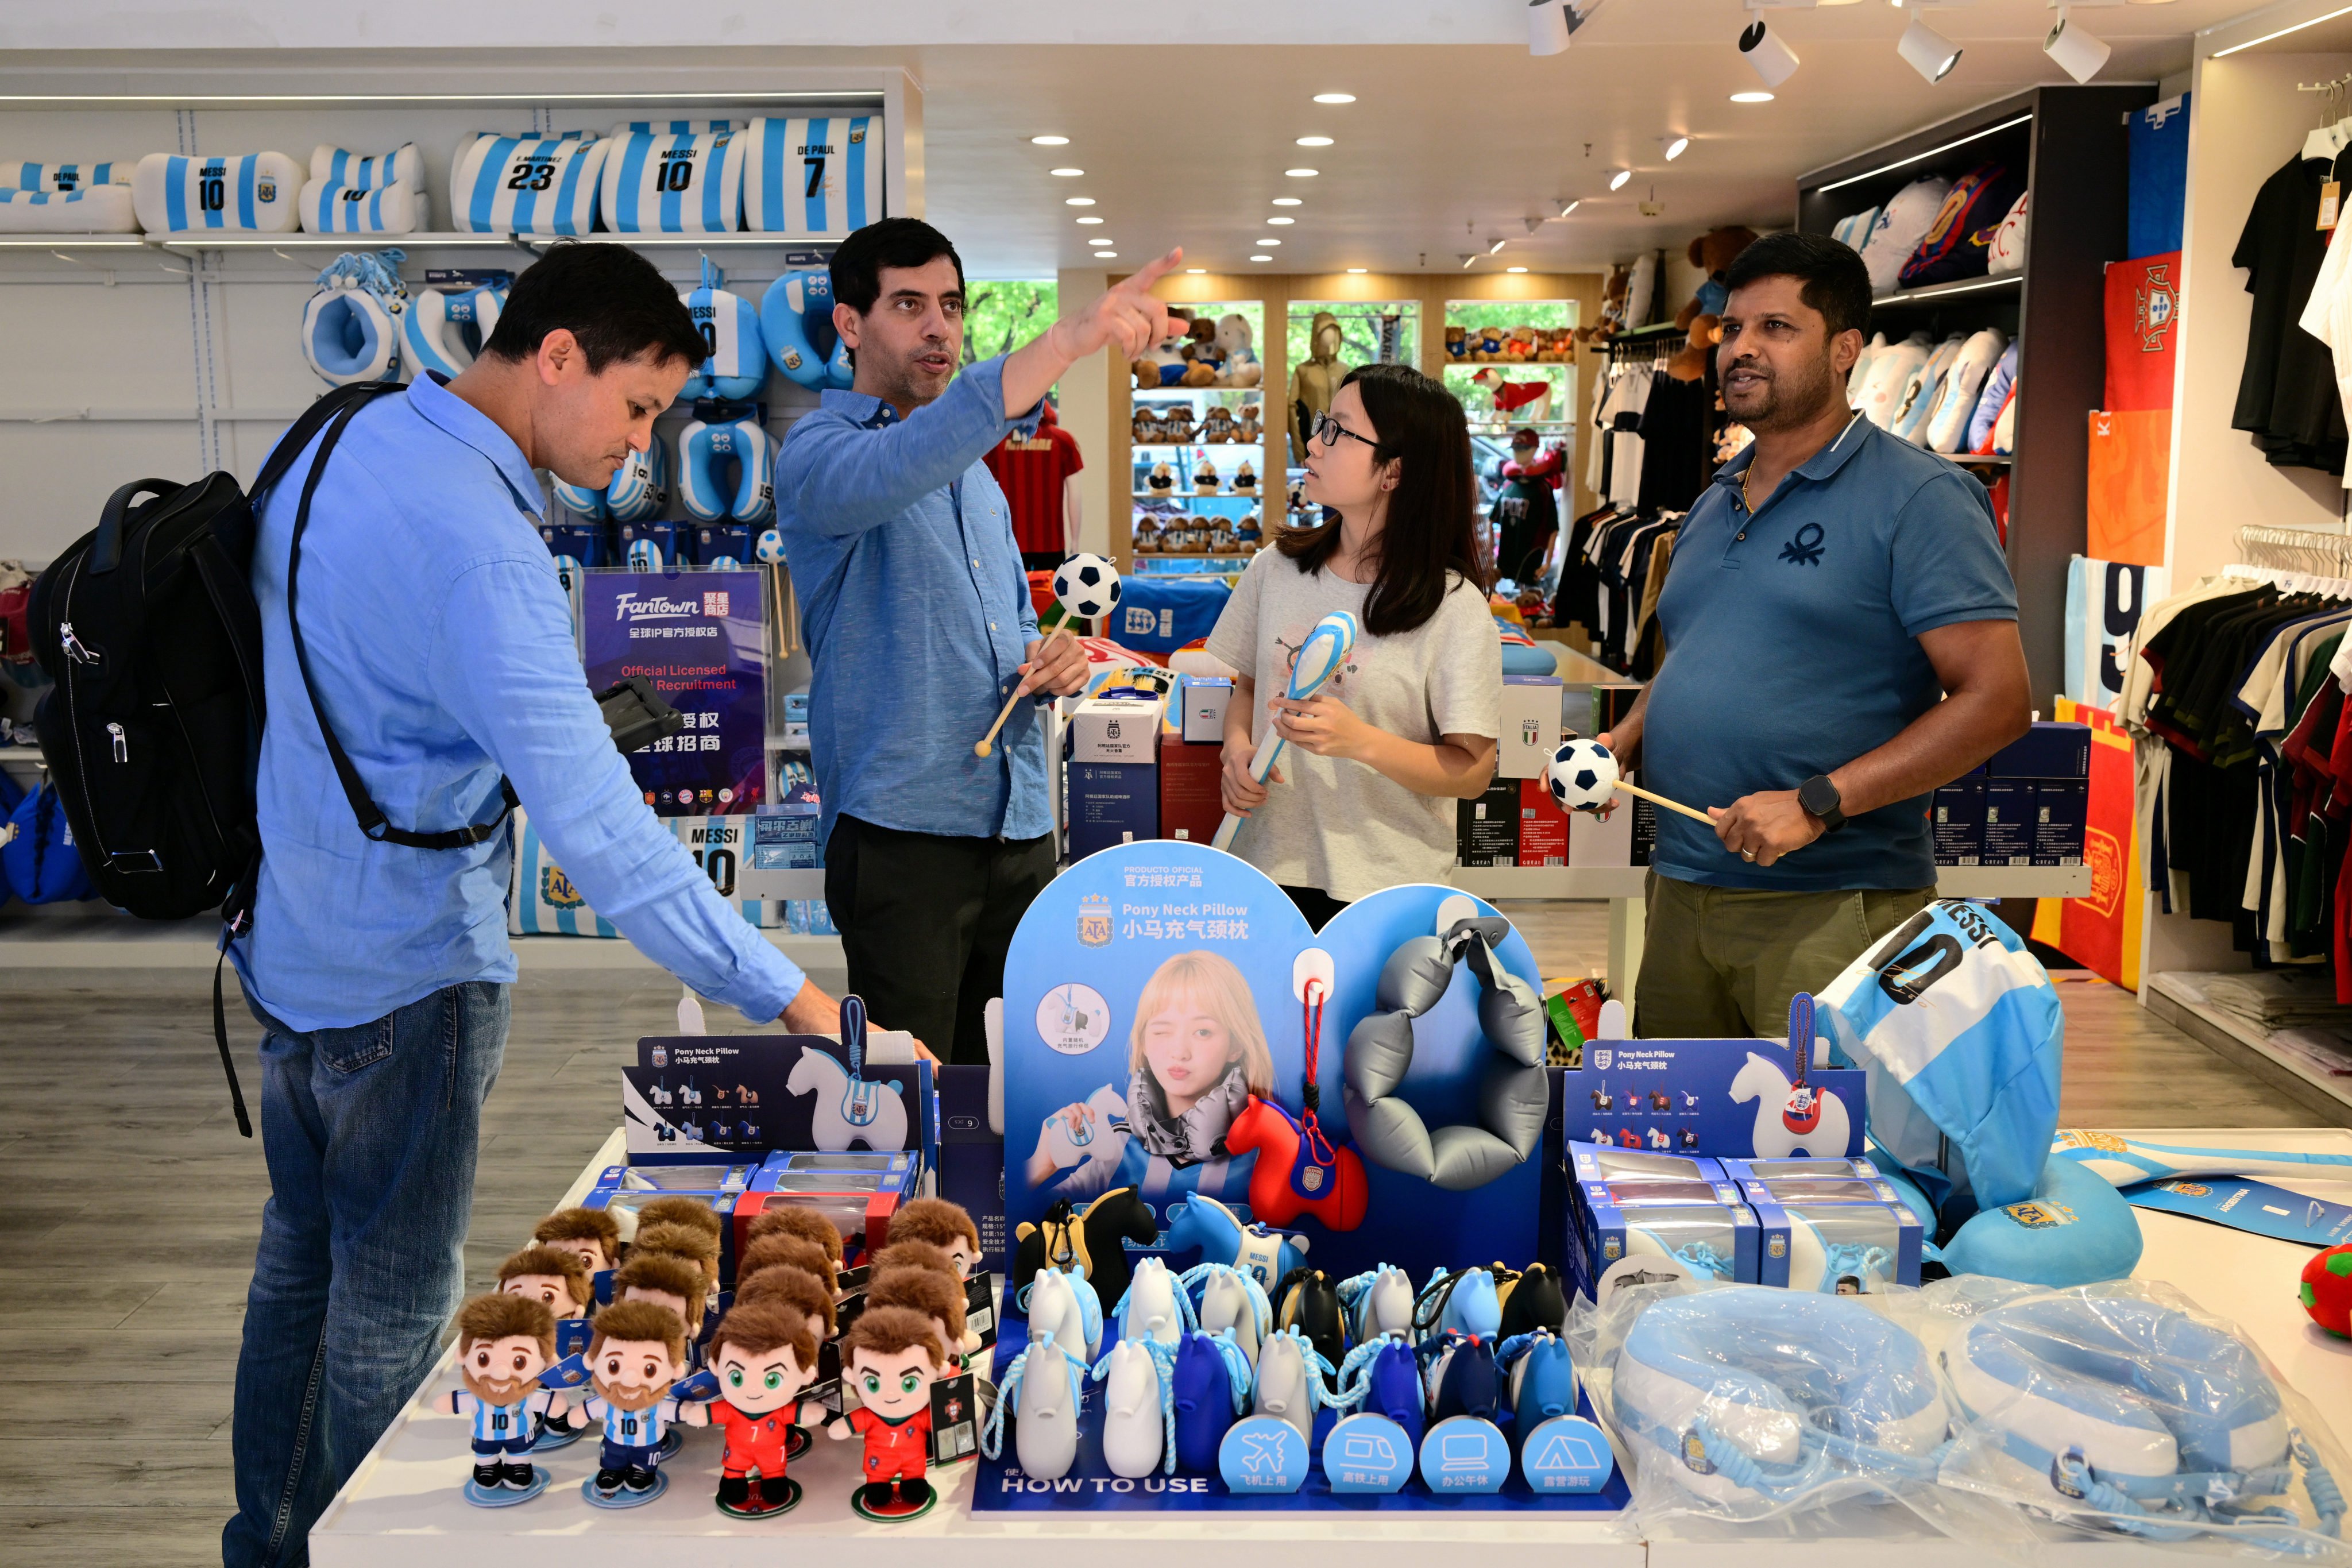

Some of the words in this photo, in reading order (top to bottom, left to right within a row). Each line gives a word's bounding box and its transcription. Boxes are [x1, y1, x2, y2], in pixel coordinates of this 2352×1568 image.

[661, 149, 697, 159] MESSI
[798, 146, 810, 155] DE
[813, 145, 835, 155] PAUL
[199, 167, 226, 176] MESSI
[508, 164, 556, 191] 23
[656, 161, 693, 191] 10
[804, 157, 825, 198] 7
[199, 179, 225, 211] 10
[689, 306, 716, 318] ESSI
[698, 322, 717, 357] 0
[616, 593, 700, 621] FanTown
[629, 627, 717, 638] 全球IP官方授权店
[621, 665, 666, 677] Official
[670, 664, 727, 675] Licensed
[657, 679, 736, 690] Recruitment
[691, 828, 738, 844] MESSI
[1124, 874, 1202, 887] 官方授权产品
[1122, 904, 1159, 918] Pony
[1163, 903, 1199, 916] Neck
[1203, 903, 1248, 916] Pillow
[1122, 919, 1249, 940] 小马充气颈枕
[1937, 899, 2000, 951] MESSI
[1867, 910, 1963, 1005] 10
[1619, 1051, 1636, 1059] Pony
[1617, 1061, 1667, 1070] 小马充气颈枕
[2219, 1188, 2250, 1212] ARGENTINA
[1250, 1252, 1268, 1262] MESSI
[492, 1414, 509, 1431] 10
[621, 1419, 638, 1435] 10
[752, 1426, 758, 1442] 7
[890, 1432, 898, 1448] 7
[648, 1451, 661, 1466] 10
[1002, 1478, 1083, 1492] HOW
[1090, 1478, 1135, 1492] TO
[1144, 1477, 1209, 1493] USE
[1239, 1474, 1287, 1486] 飞机上用
[1343, 1472, 1389, 1486] 高铁上用
[1442, 1476, 1489, 1487] 办公午休
[1543, 1476, 1590, 1488] 露营游玩
